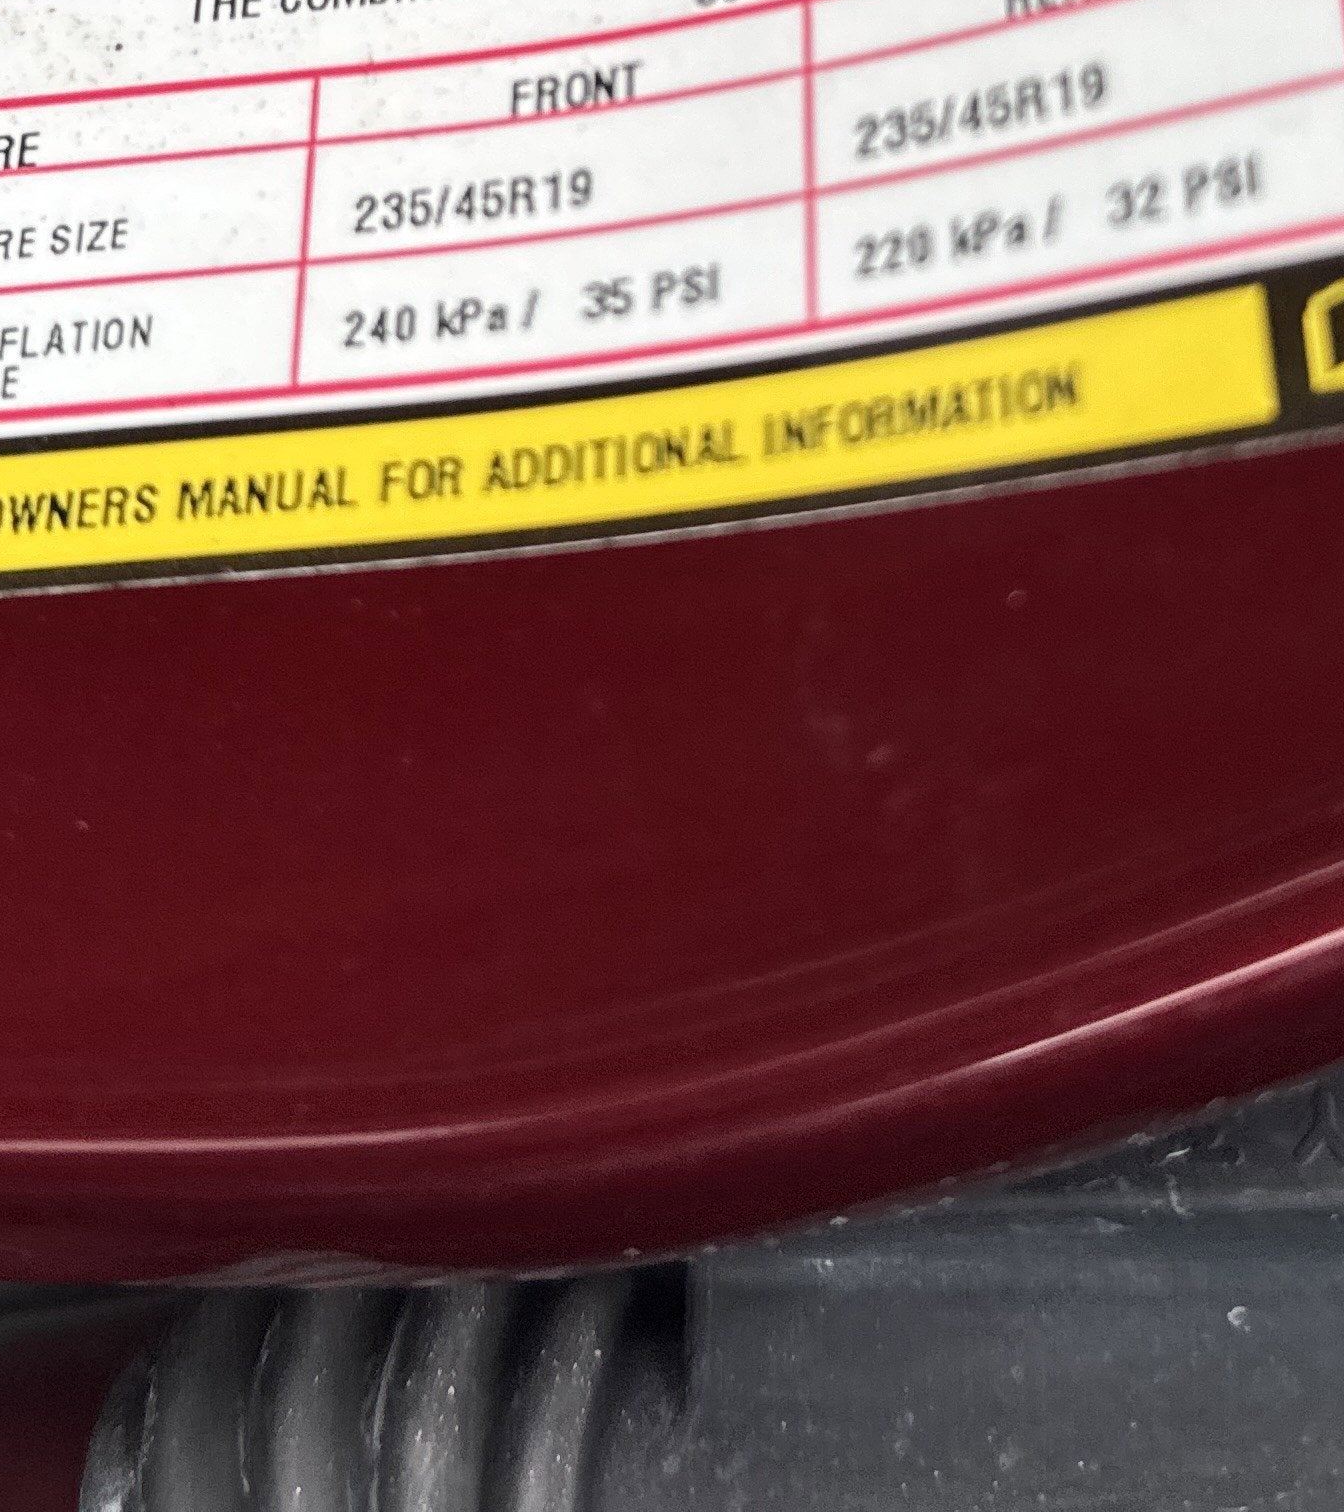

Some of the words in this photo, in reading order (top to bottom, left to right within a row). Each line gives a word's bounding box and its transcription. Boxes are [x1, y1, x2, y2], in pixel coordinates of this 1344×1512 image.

[510, 62, 645, 118] FRONT
[855, 62, 1110, 160] 235/45R19
[50, 218, 130, 254] SIZE
[355, 168, 595, 235] 235/45R19
[855, 229, 934, 281] 220
[1107, 179, 1162, 226] 32
[1181, 154, 1264, 213] PSI
[342, 305, 417, 349] 240
[582, 279, 636, 321] 35
[653, 263, 724, 310] PSI
[176, 463, 356, 521] MANUAL
[380, 456, 464, 506] FOR
[482, 422, 744, 492] ADDITIONAL
[762, 359, 1082, 458] INFORMATION
